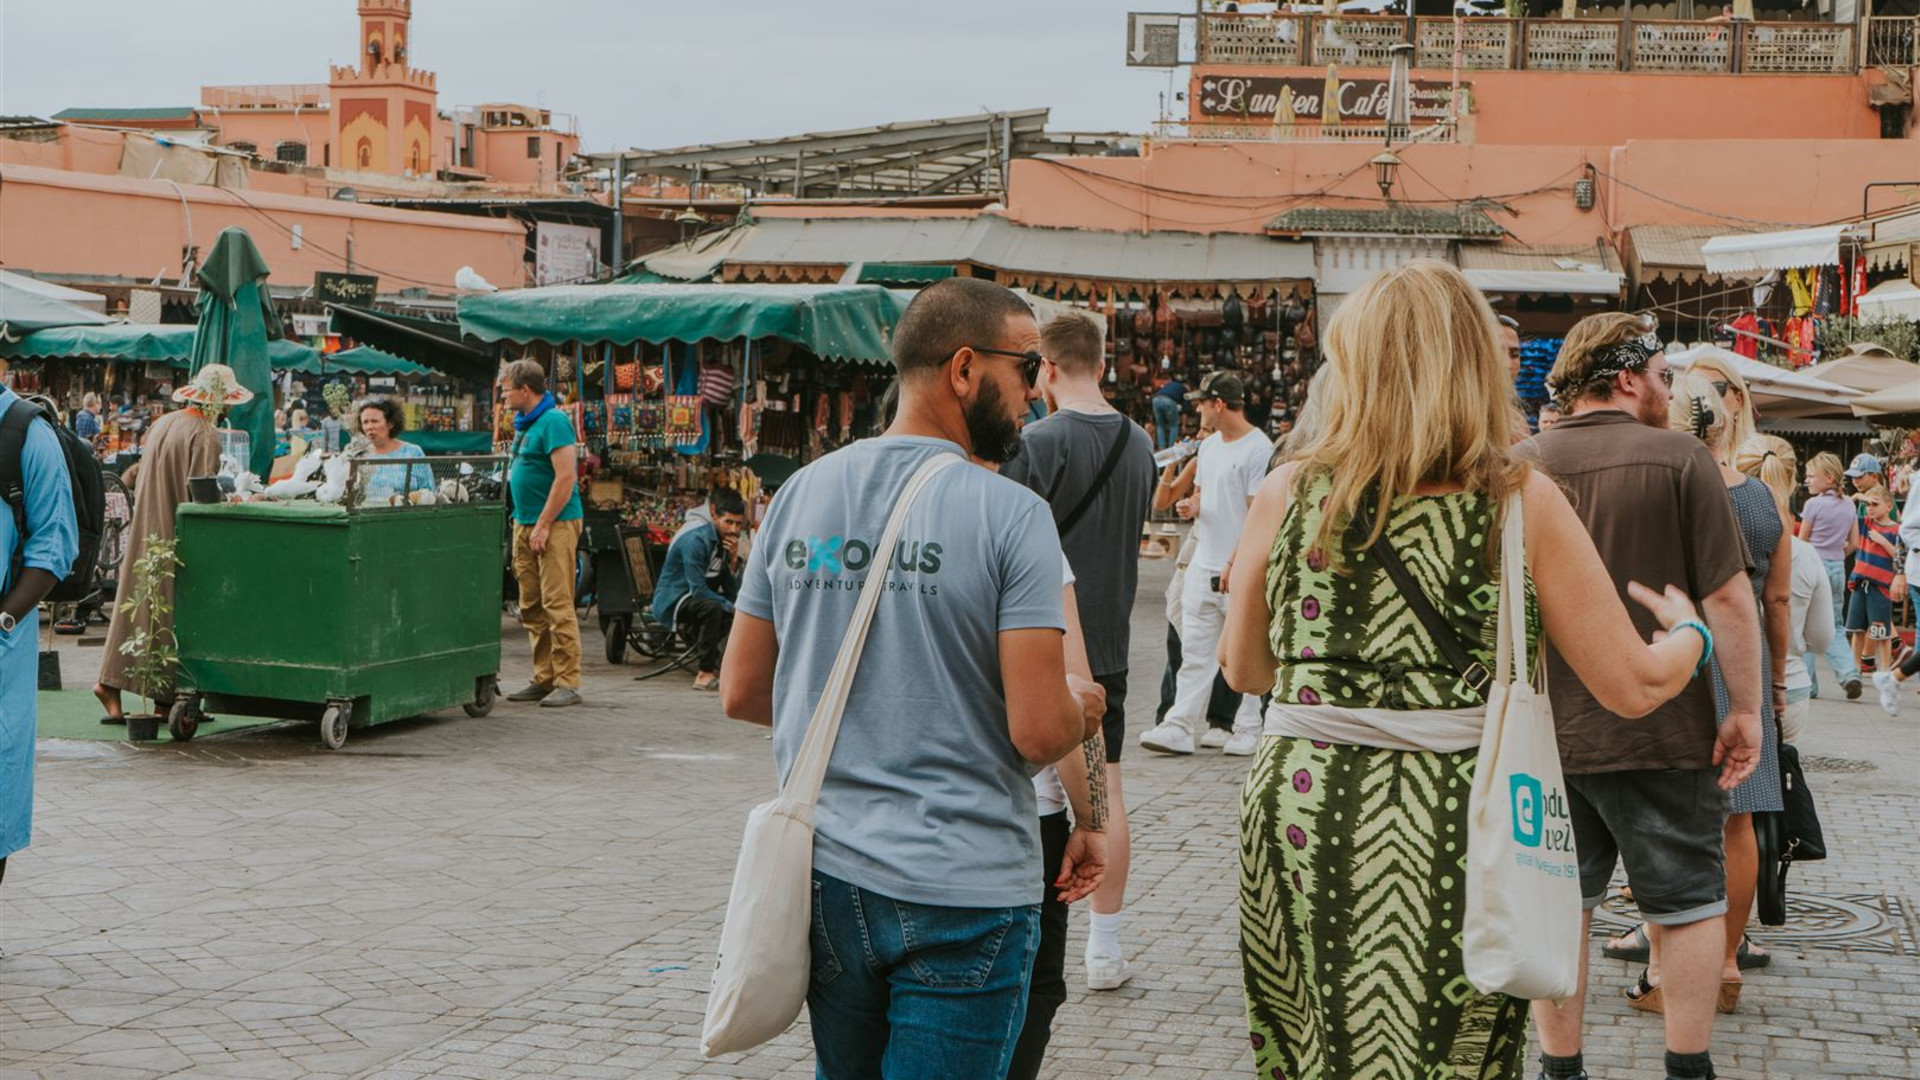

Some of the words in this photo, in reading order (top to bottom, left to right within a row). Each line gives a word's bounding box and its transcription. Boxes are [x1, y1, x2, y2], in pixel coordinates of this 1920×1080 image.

[1217, 79, 1319, 114] L'anien
[786, 536, 943, 574] exous
[789, 578, 865, 592] ADVENTUR
[1870, 625, 1886, 637] 90
